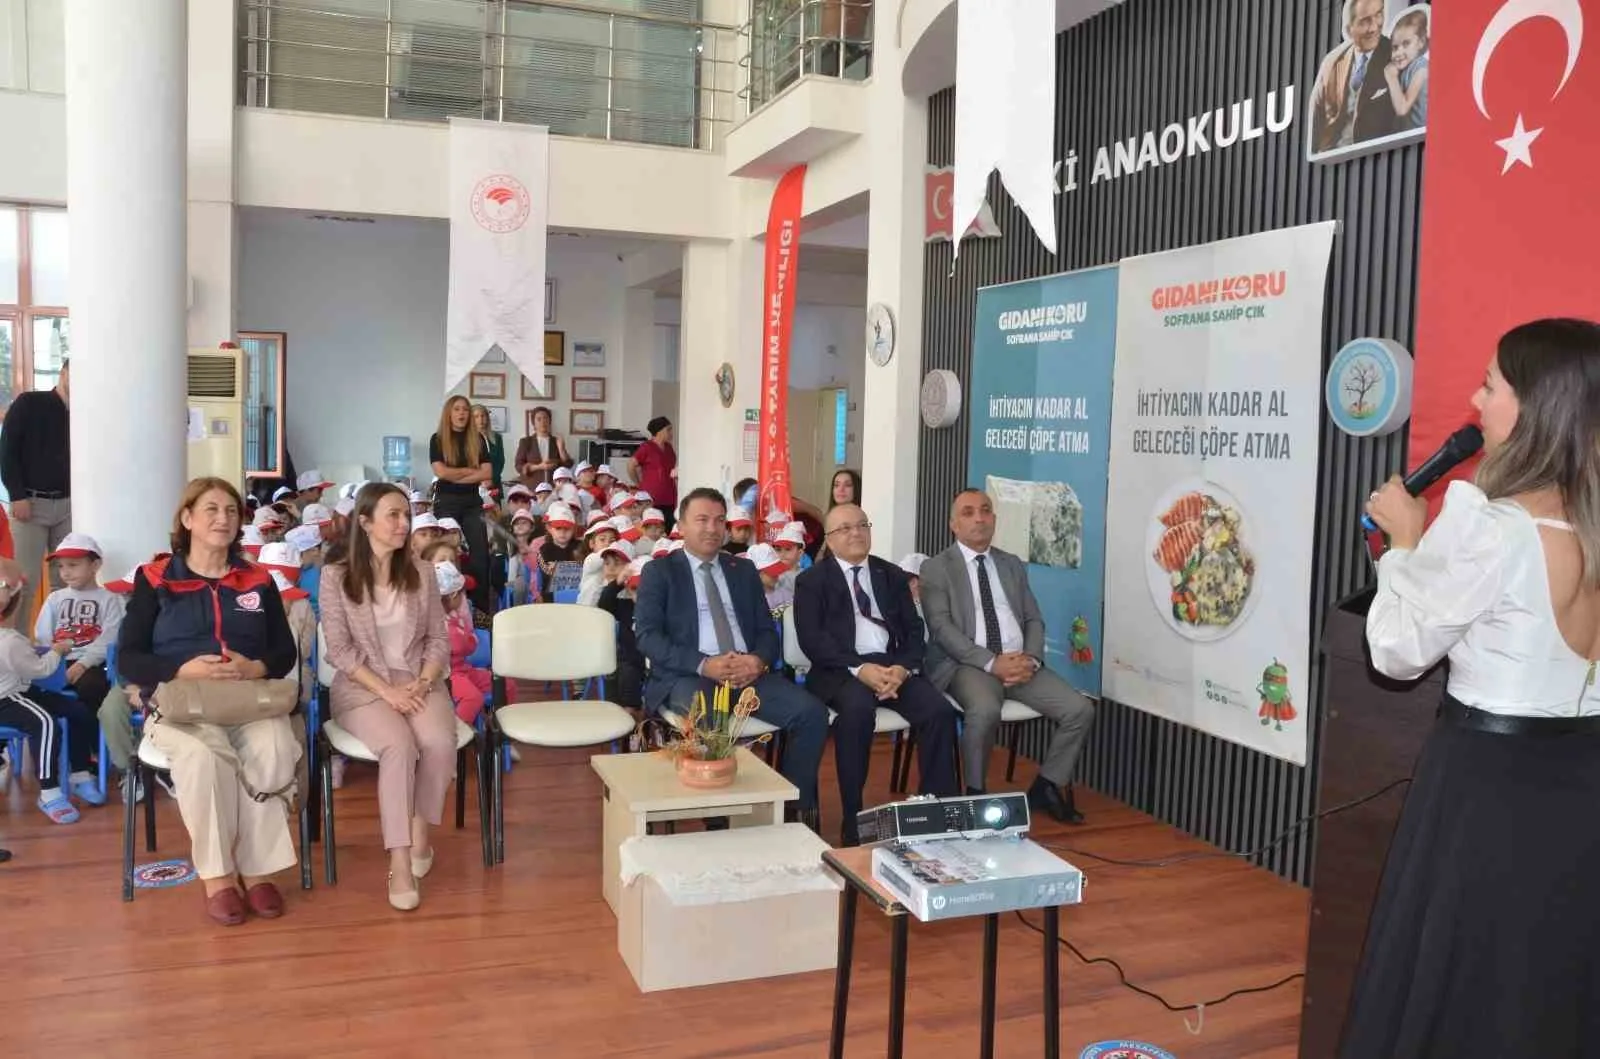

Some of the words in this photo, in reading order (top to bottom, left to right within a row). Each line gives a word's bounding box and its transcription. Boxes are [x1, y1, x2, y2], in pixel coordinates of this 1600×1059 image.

[1053, 149, 1078, 194] Kİ
[1090, 85, 1295, 184] ANAOKULU
[1152, 279, 1219, 310] GIDANI
[1221, 270, 1287, 301] KORU
[998, 308, 1045, 331] GIDANI
[1046, 301, 1088, 325] KORU
[1164, 310, 1212, 328] SOFRANA
[769, 335, 781, 415] TARIM
[989, 394, 1033, 419] İHTİYACIN
[1035, 397, 1071, 420] KADAR
[1074, 397, 1089, 420] AL
[1137, 388, 1202, 417] İHTİYACIN
[1208, 391, 1262, 417] KADAR
[1268, 390, 1288, 417] AL
[985, 426, 1027, 450] GELECEĞİ
[1029, 427, 1056, 455] ÇÖPE
[1058, 431, 1089, 454] ATMA
[1133, 426, 1195, 455] GELECEĞİ
[1200, 426, 1239, 461] ÇÖPE
[1243, 432, 1290, 459] ATMA
